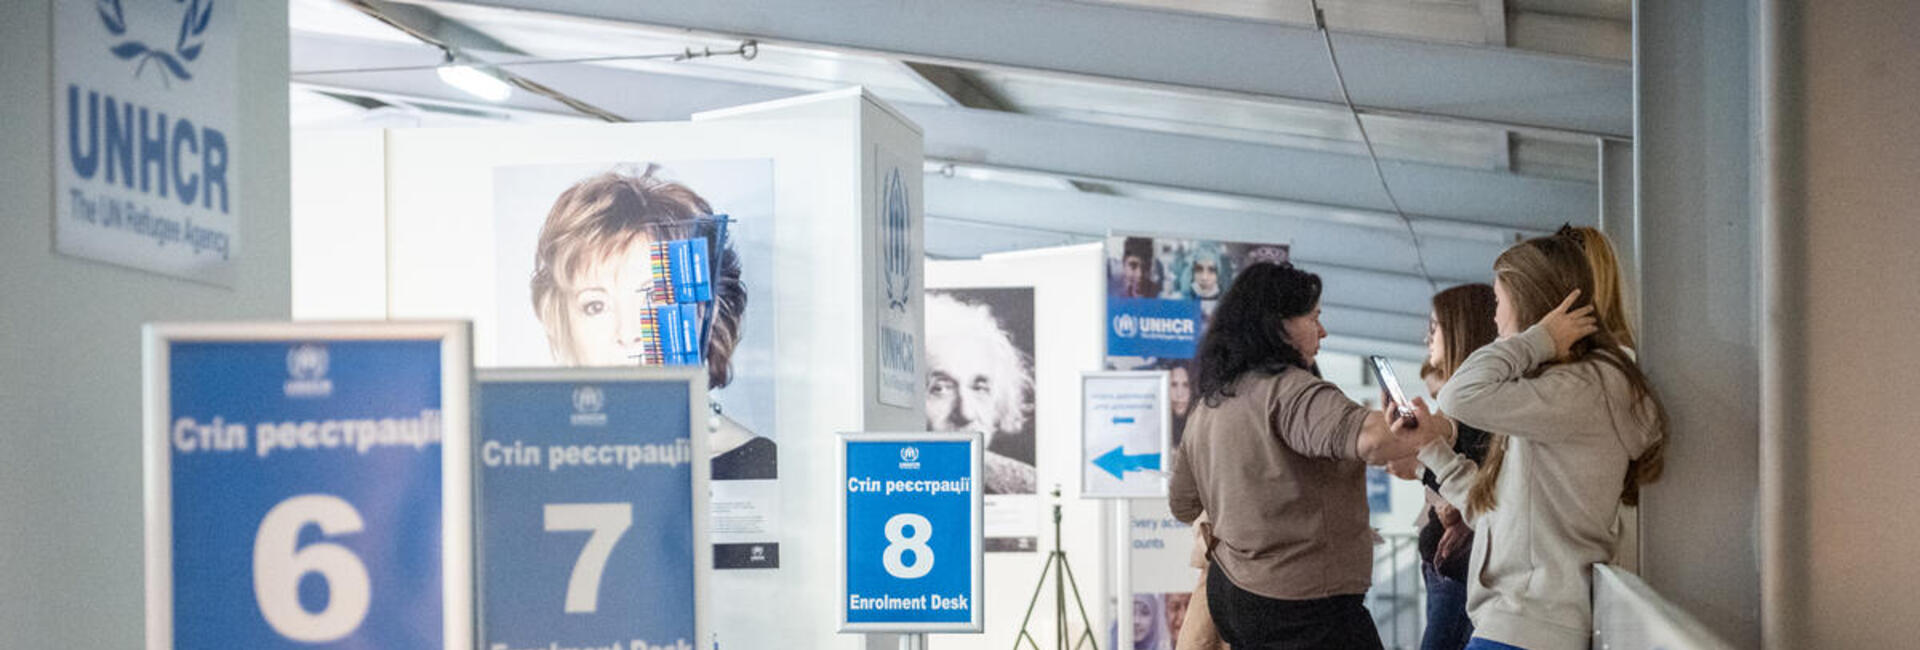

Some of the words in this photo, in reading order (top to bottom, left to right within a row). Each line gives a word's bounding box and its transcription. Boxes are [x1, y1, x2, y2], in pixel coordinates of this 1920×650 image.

[68, 84, 229, 214] UNHCR
[69, 188, 97, 225] The
[101, 197, 122, 228] UN
[126, 201, 180, 247] Refugee
[184, 217, 230, 261] Agency
[1140, 316, 1194, 333] UNHCR
[173, 414, 248, 452] Стіл
[482, 440, 541, 467] Стіл
[548, 437, 691, 471] реєстрації
[847, 477, 881, 493] Стіл
[886, 477, 970, 496] реєстрації
[543, 502, 633, 613] 7
[883, 512, 935, 579] 8
[1132, 538, 1165, 549] ounts
[253, 492, 371, 643] 6
[850, 594, 927, 610] Enrolment
[931, 594, 969, 610] Desk
